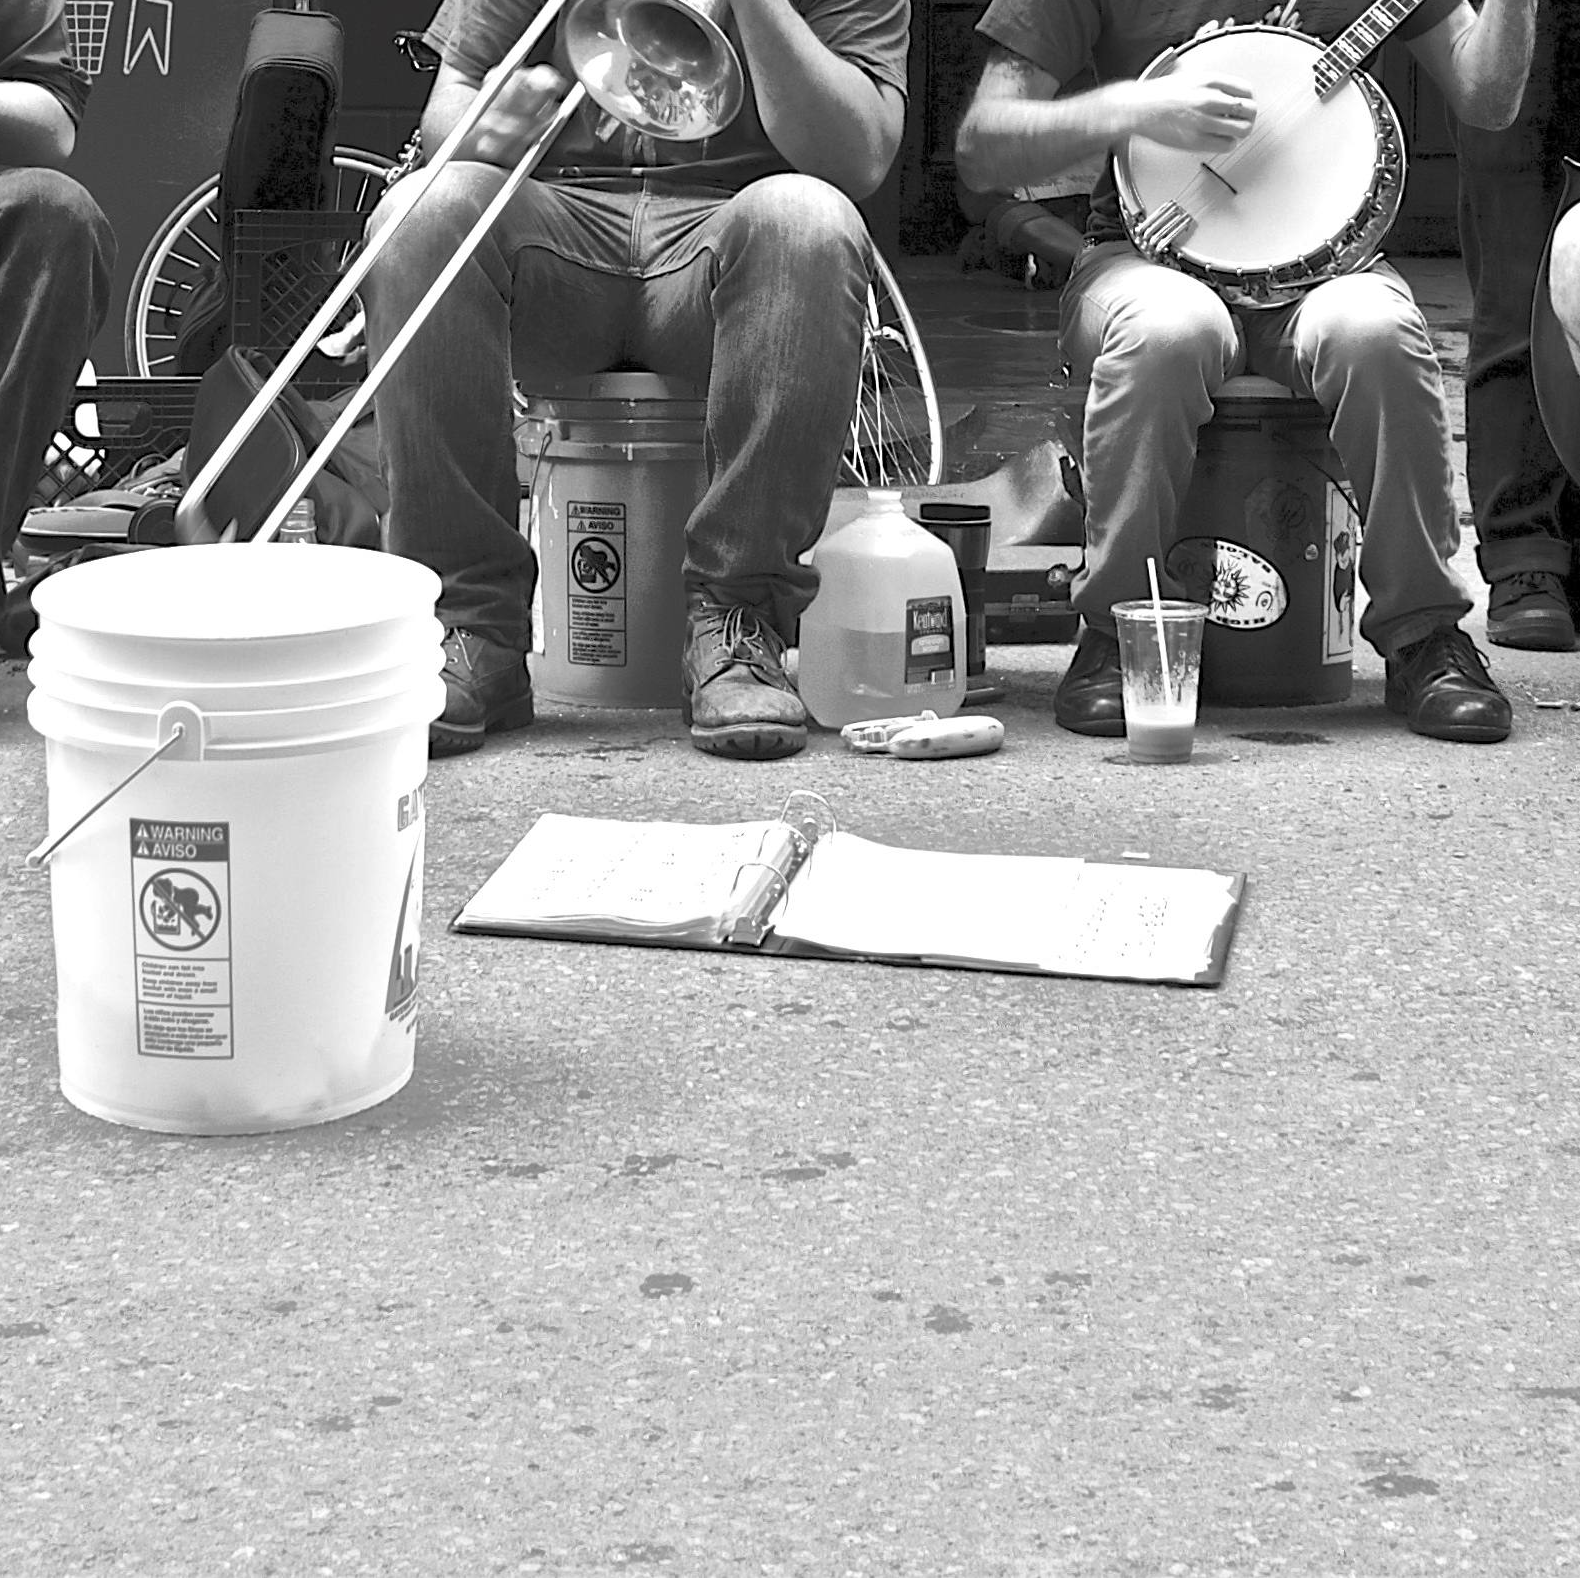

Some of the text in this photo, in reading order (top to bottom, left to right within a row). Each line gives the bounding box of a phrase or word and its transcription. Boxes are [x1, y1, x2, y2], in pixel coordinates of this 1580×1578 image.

[580, 506, 620, 515] WARNING
[588, 521, 615, 530] AVISO
[150, 825, 224, 841] WARNING
[152, 844, 197, 859] AVISO
